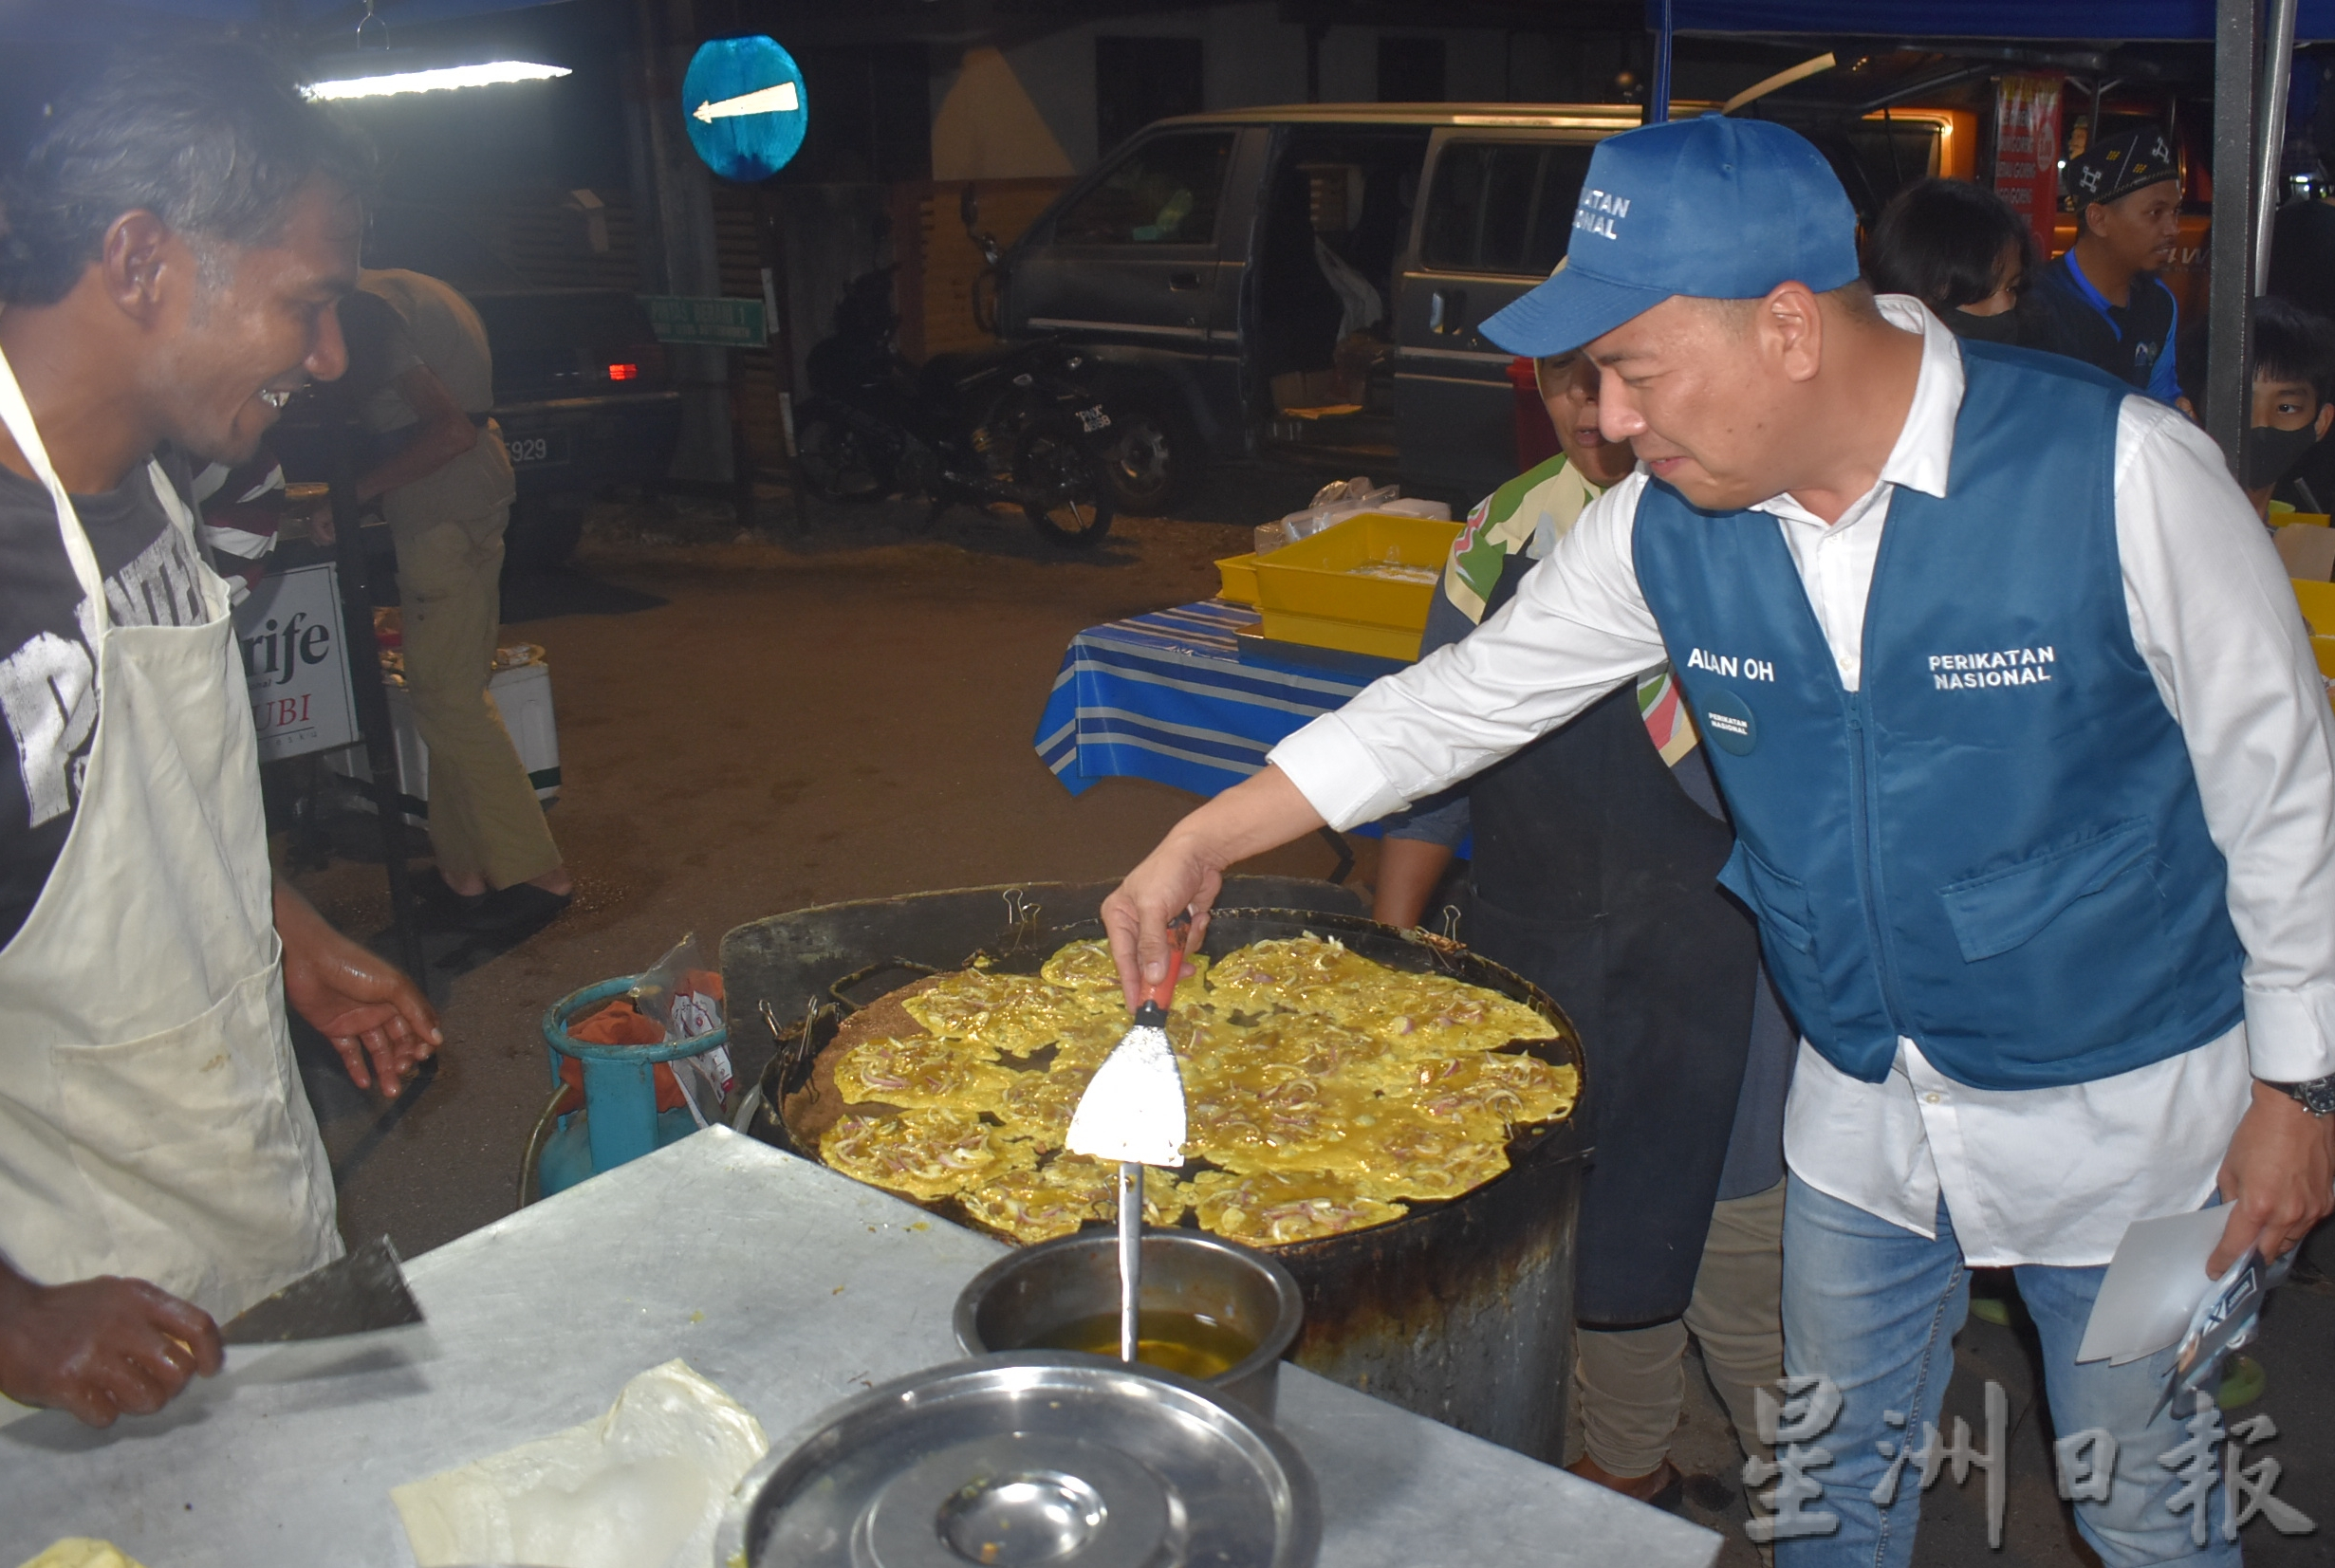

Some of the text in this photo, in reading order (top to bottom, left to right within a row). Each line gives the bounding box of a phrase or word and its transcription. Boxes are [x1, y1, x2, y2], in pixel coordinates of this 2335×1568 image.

[1687, 648, 1775, 683] ALAN OH
[1929, 645, 2055, 672] PERIKATAN
[1934, 666, 2051, 690] NASIONAL
[1708, 711, 1749, 729] PERIKATAN
[1712, 720, 1749, 736] NASIONAL
